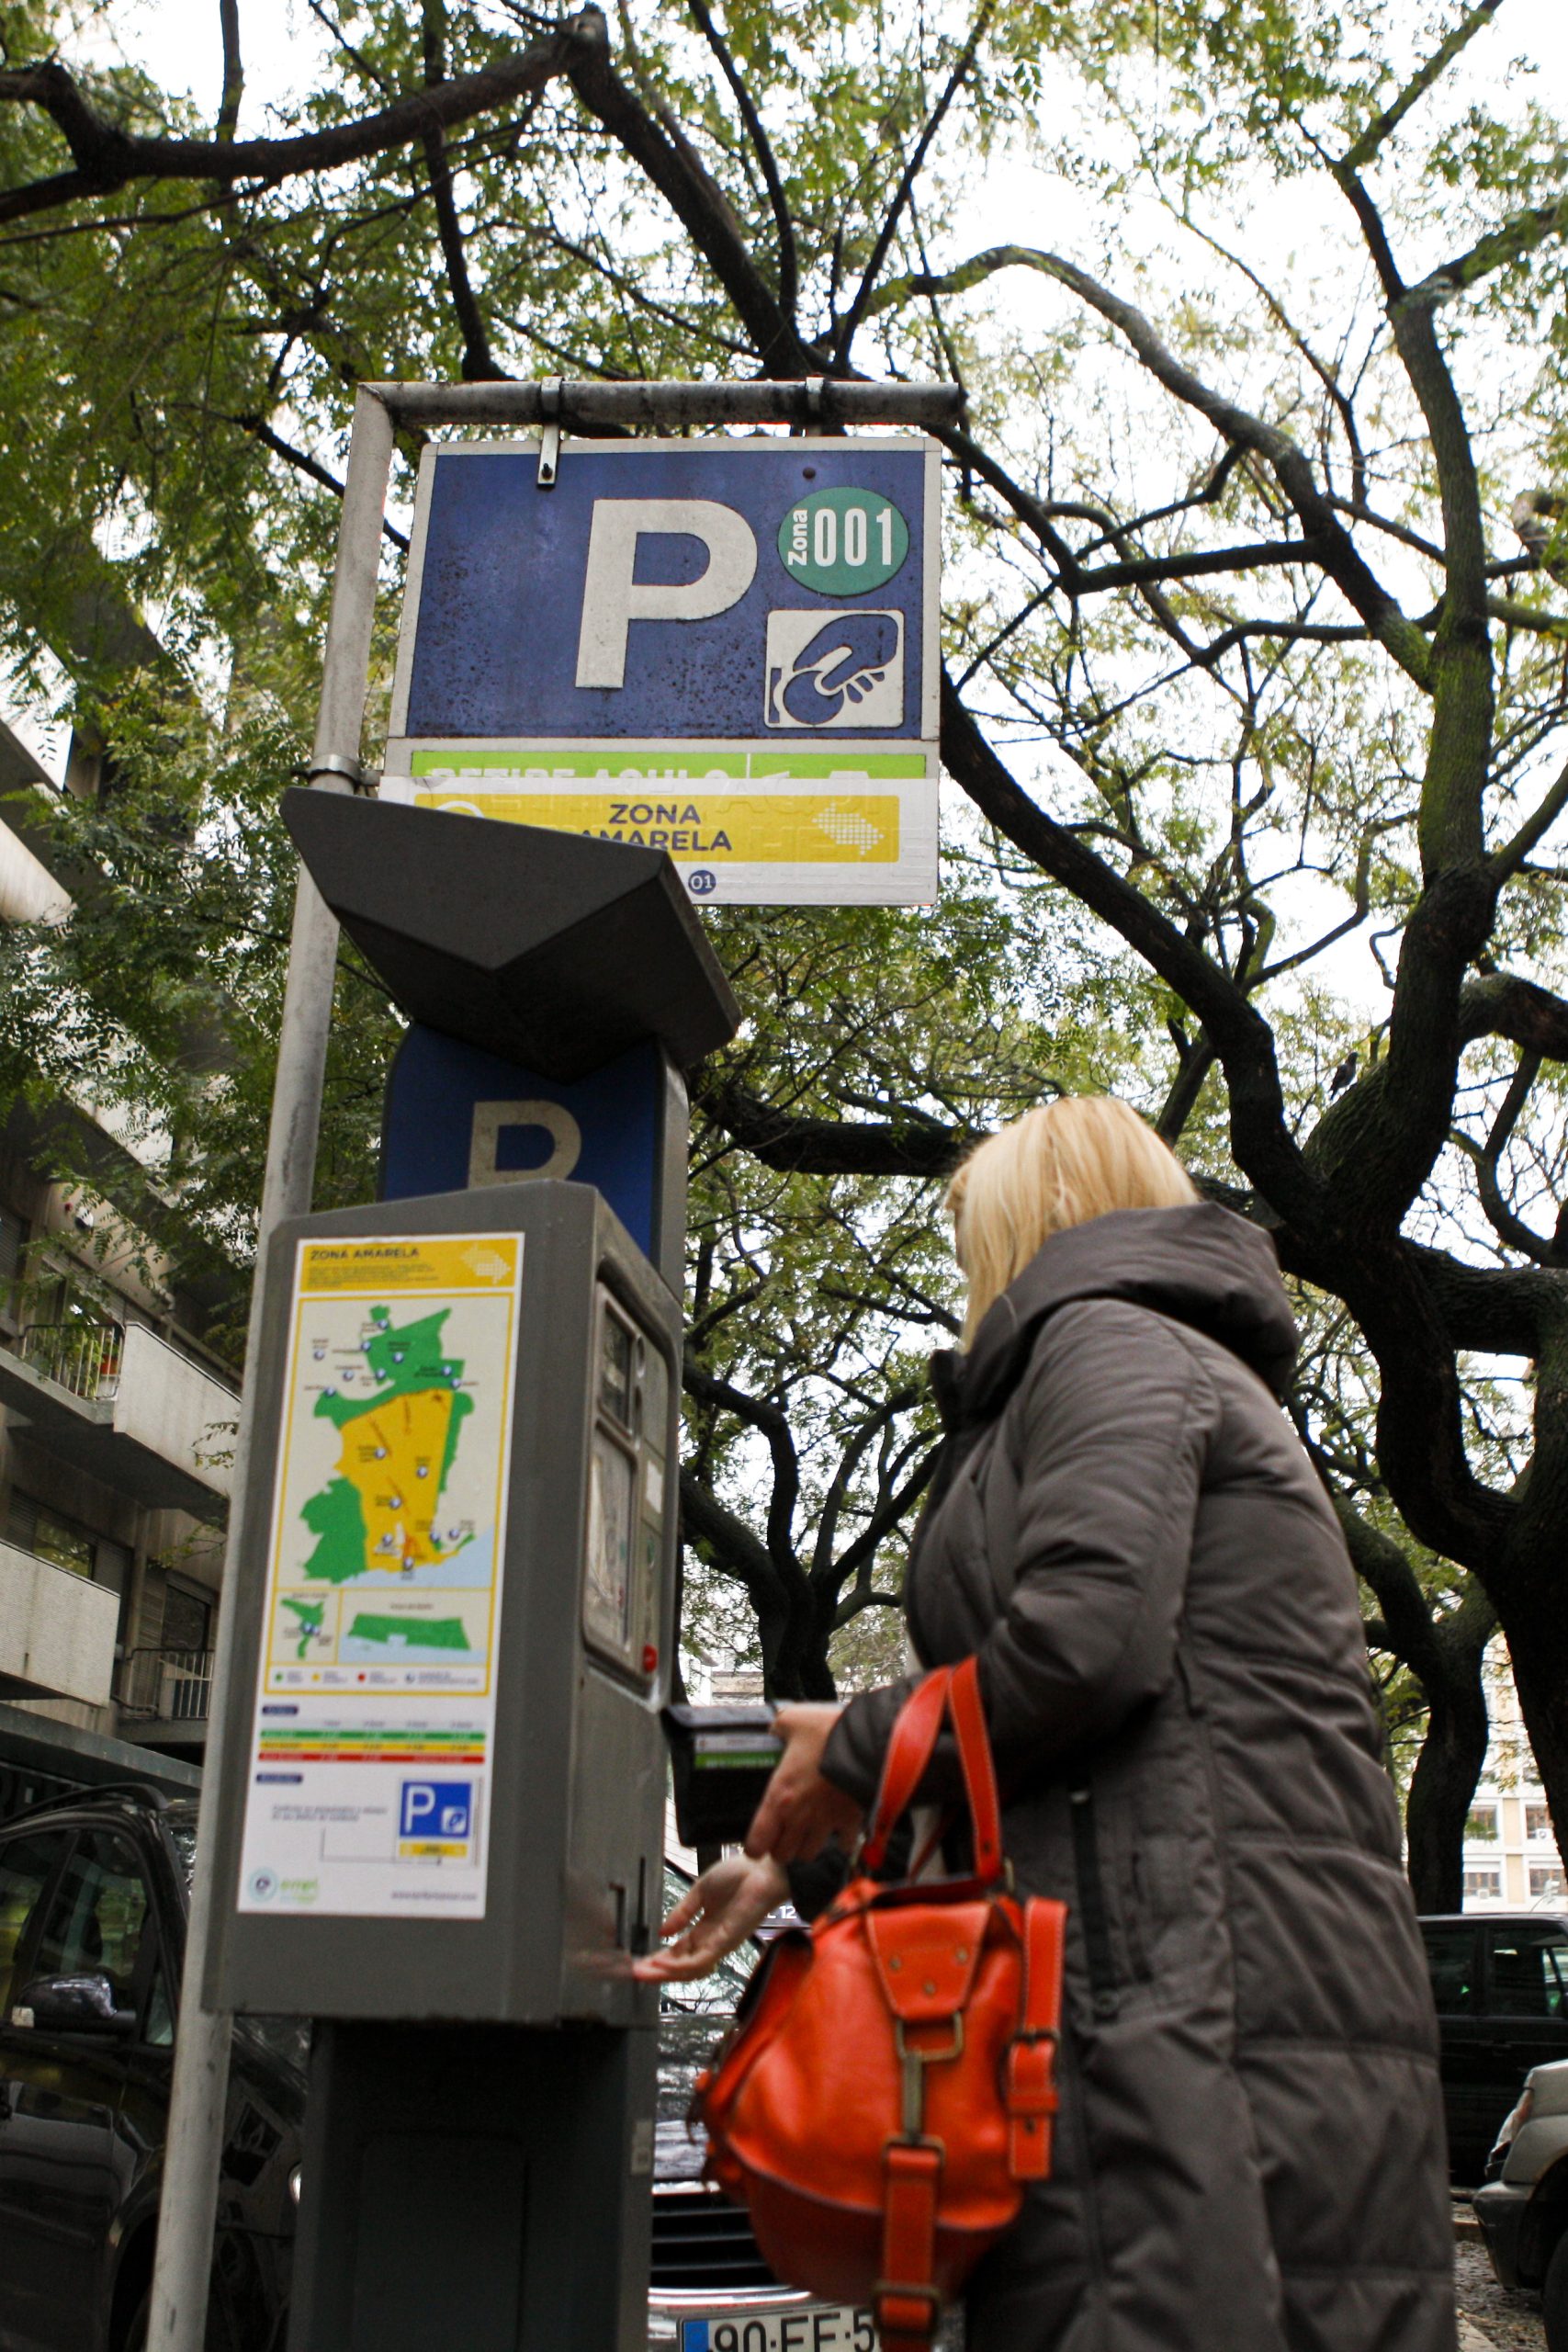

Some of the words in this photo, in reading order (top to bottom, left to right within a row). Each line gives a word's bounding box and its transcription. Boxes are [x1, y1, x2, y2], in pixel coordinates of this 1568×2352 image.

[788, 509, 808, 566] Zona
[814, 508, 893, 567] 001
[575, 499, 758, 689] P
[607, 803, 702, 824] ZONA
[691, 875, 714, 890] 01
[310, 1249, 349, 1261] ZONA
[353, 1247, 420, 1260] AMARELA
[403, 1784, 436, 1834] P
